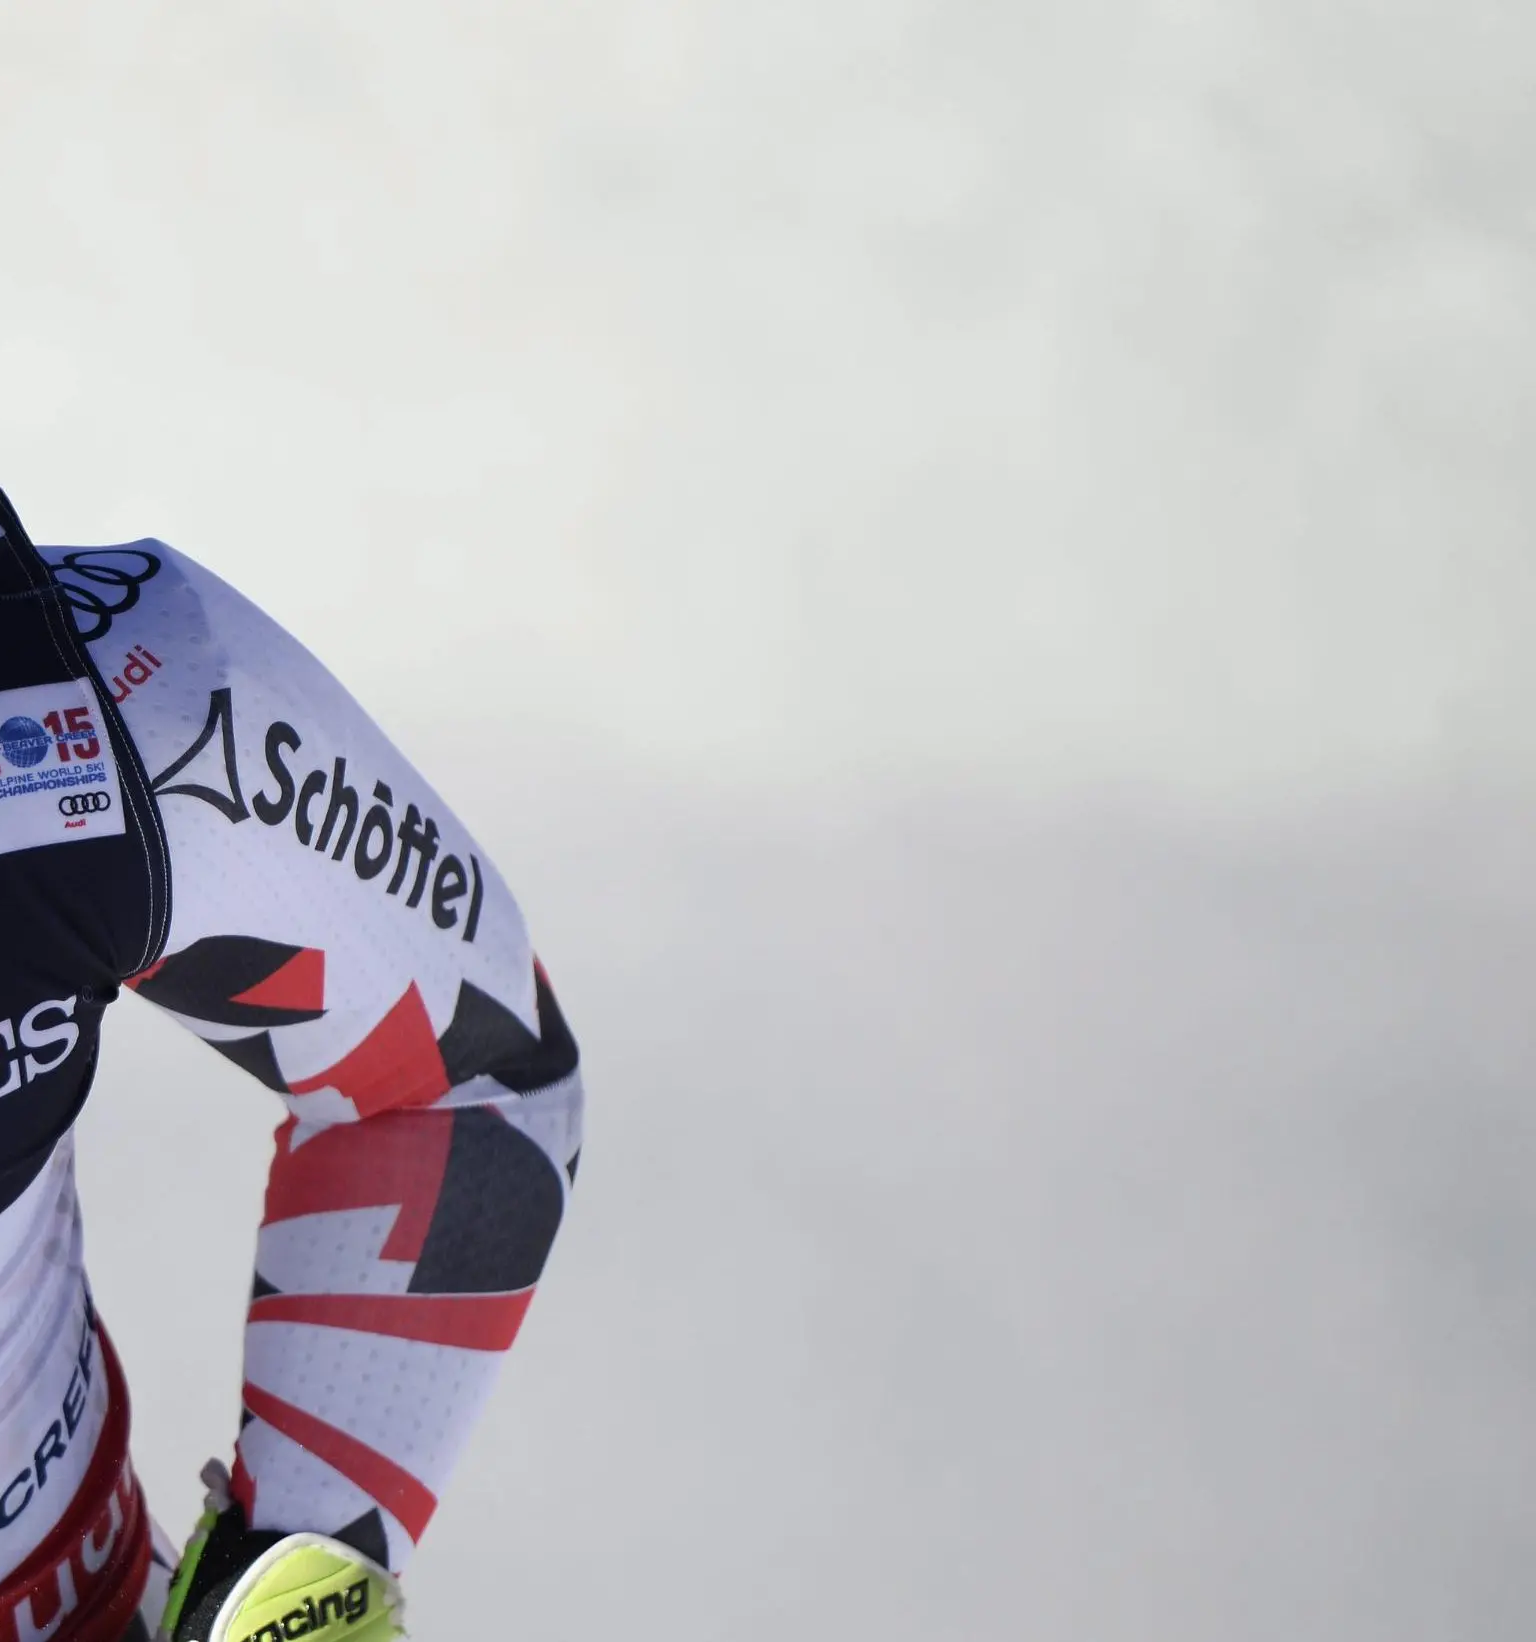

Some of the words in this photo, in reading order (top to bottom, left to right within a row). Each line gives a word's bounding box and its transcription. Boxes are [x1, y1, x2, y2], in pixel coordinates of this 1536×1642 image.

[111, 644, 163, 705] udi
[38, 765, 82, 781] WORLD
[83, 762, 105, 773] SKI
[64, 818, 87, 829] Audi
